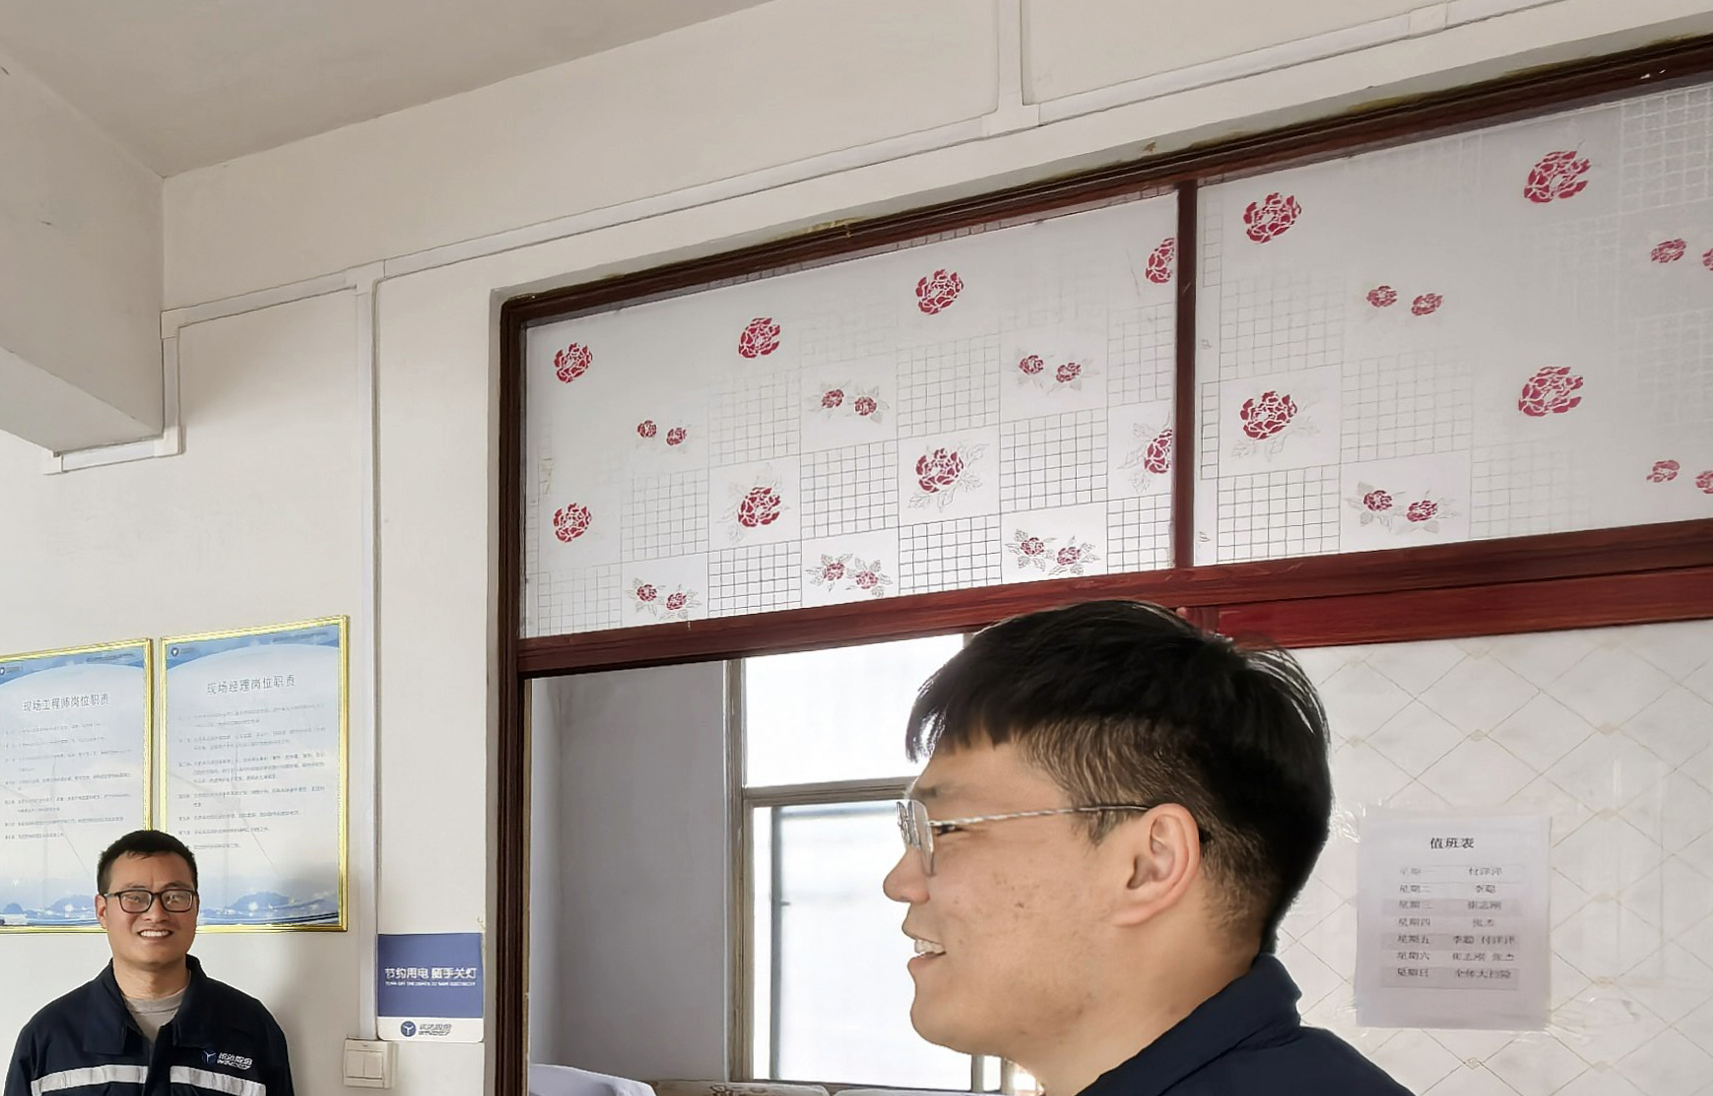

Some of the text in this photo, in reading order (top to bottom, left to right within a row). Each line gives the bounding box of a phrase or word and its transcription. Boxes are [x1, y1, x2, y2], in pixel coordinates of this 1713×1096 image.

[206, 674, 296, 695] 现场经理岗位职责
[22, 693, 109, 712] 现场工程师岗位职责
[1430, 837, 1475, 850] 值班表
[1398, 918, 1432, 927] 星期四
[1397, 935, 1430, 945] 星期五
[1397, 951, 1430, 961] 星期六
[384, 967, 477, 980] 节约用电 随手关灯
